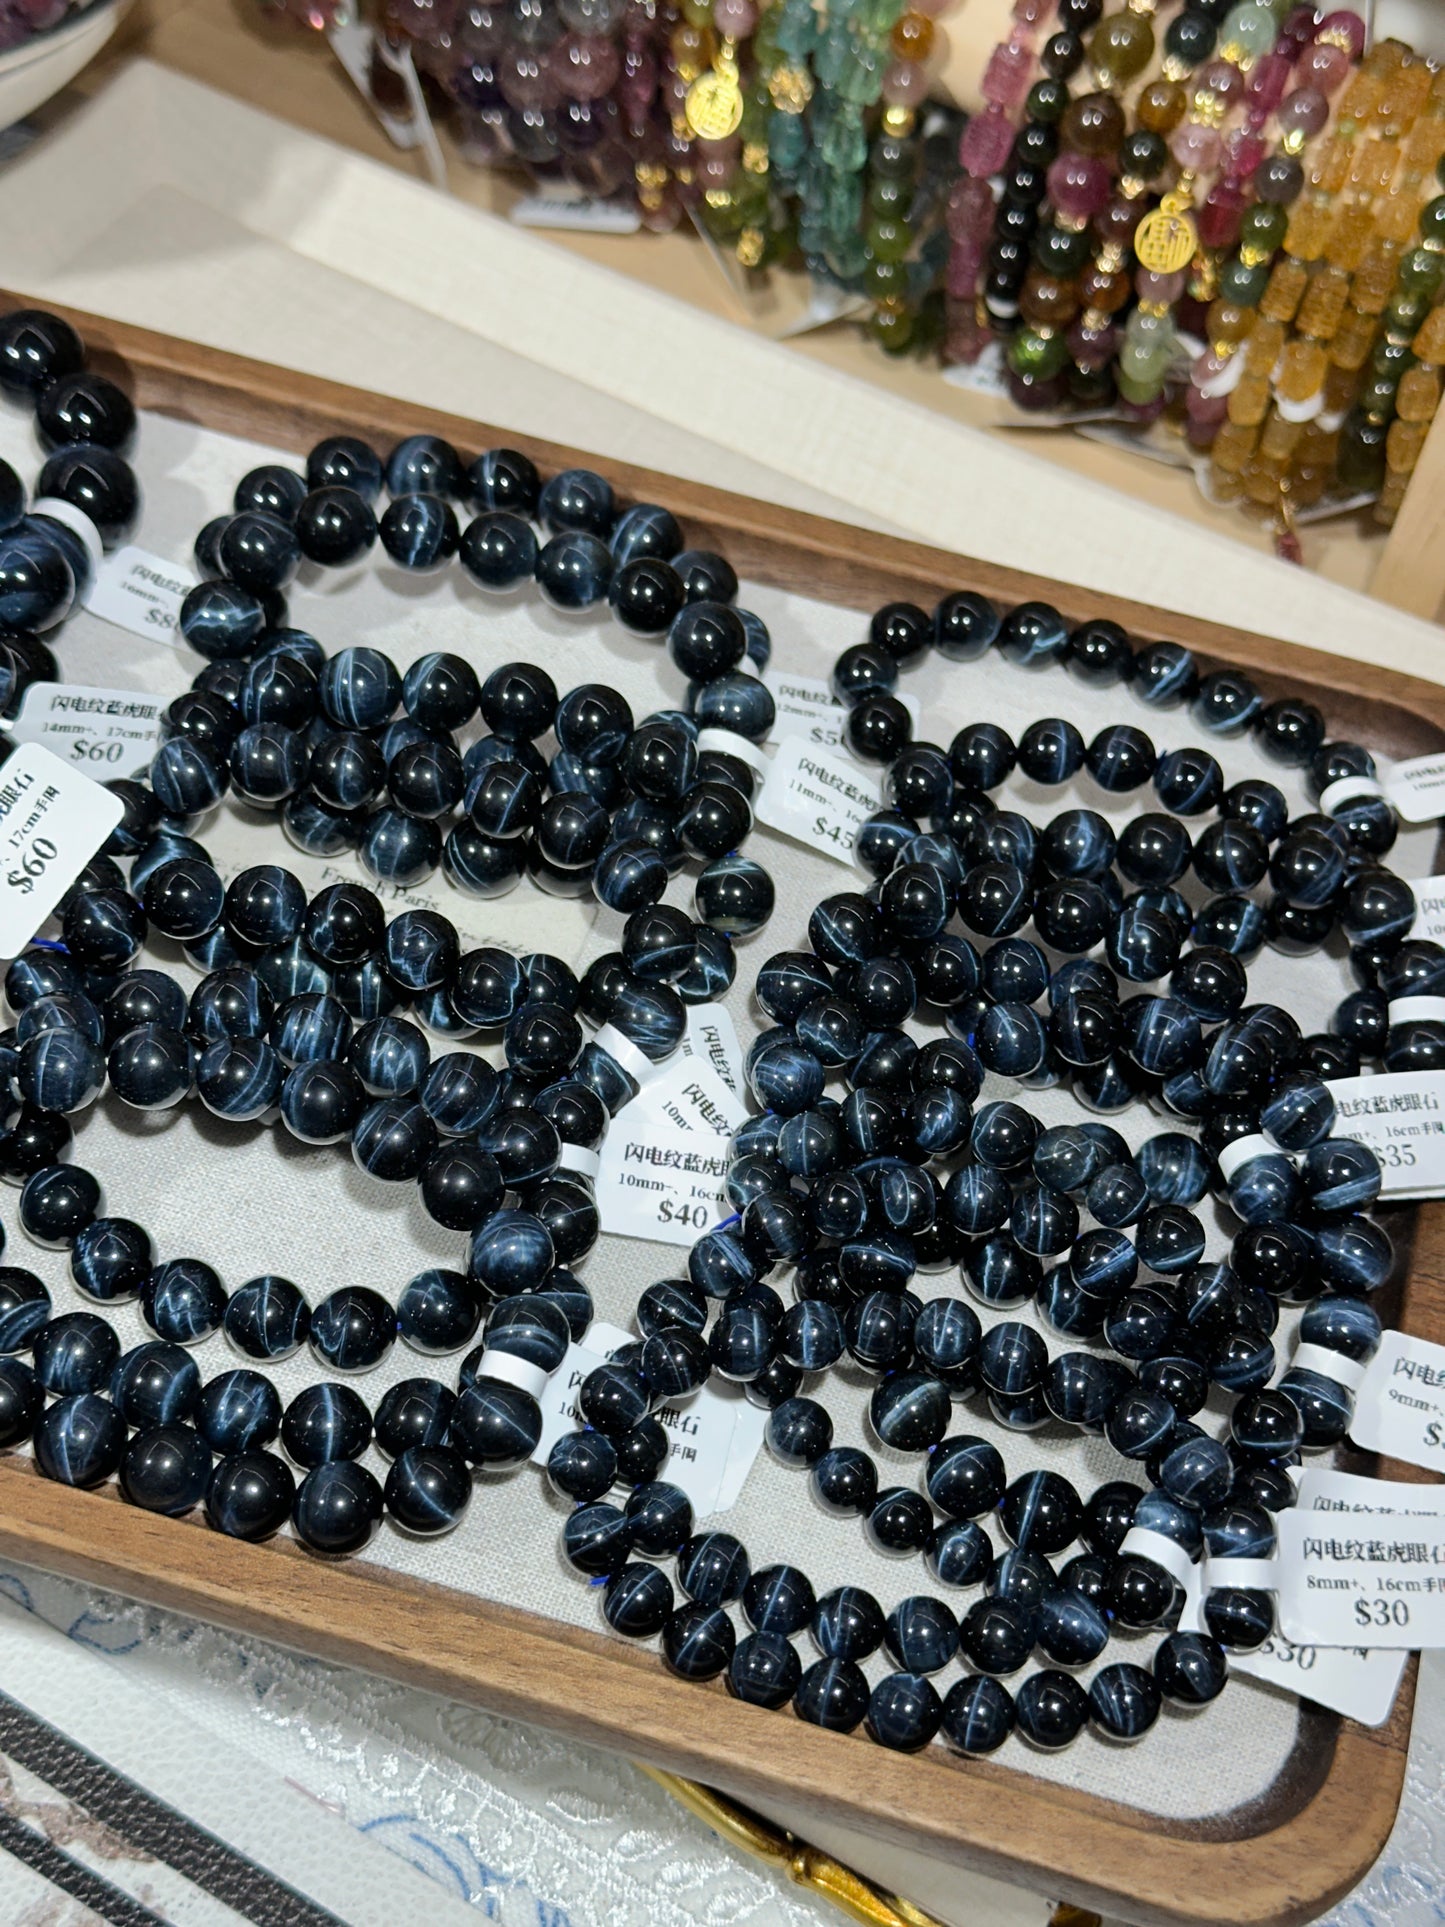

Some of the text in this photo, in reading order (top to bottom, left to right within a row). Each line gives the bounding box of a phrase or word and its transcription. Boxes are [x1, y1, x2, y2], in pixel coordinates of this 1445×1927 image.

[70, 738, 124, 763] $60
[812, 816, 855, 850] $45
[7, 837, 58, 894] $60
[681, 1083, 733, 1137] 闪电纹
[1374, 1144, 1417, 1167] $35
[657, 1199, 708, 1229] $40
[1354, 1597, 1409, 1627] $30
